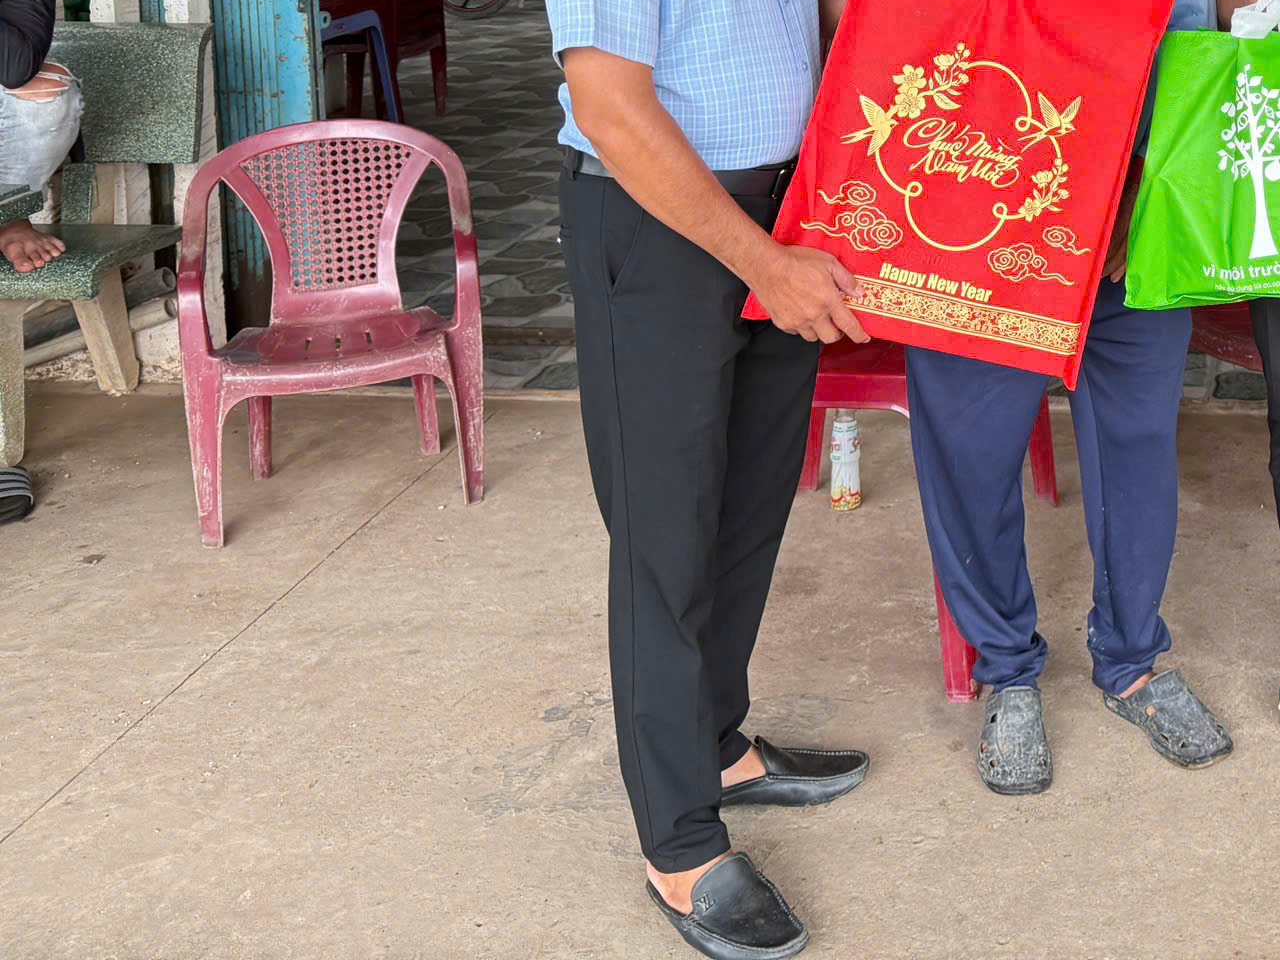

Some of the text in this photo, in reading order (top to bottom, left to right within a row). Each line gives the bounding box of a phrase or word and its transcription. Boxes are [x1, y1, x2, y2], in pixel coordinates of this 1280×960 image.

[903, 117, 971, 155] Chúc
[879, 262, 992, 302] Happy New Year
[1202, 264, 1216, 277] vì
[1220, 266, 1244, 280] môi
